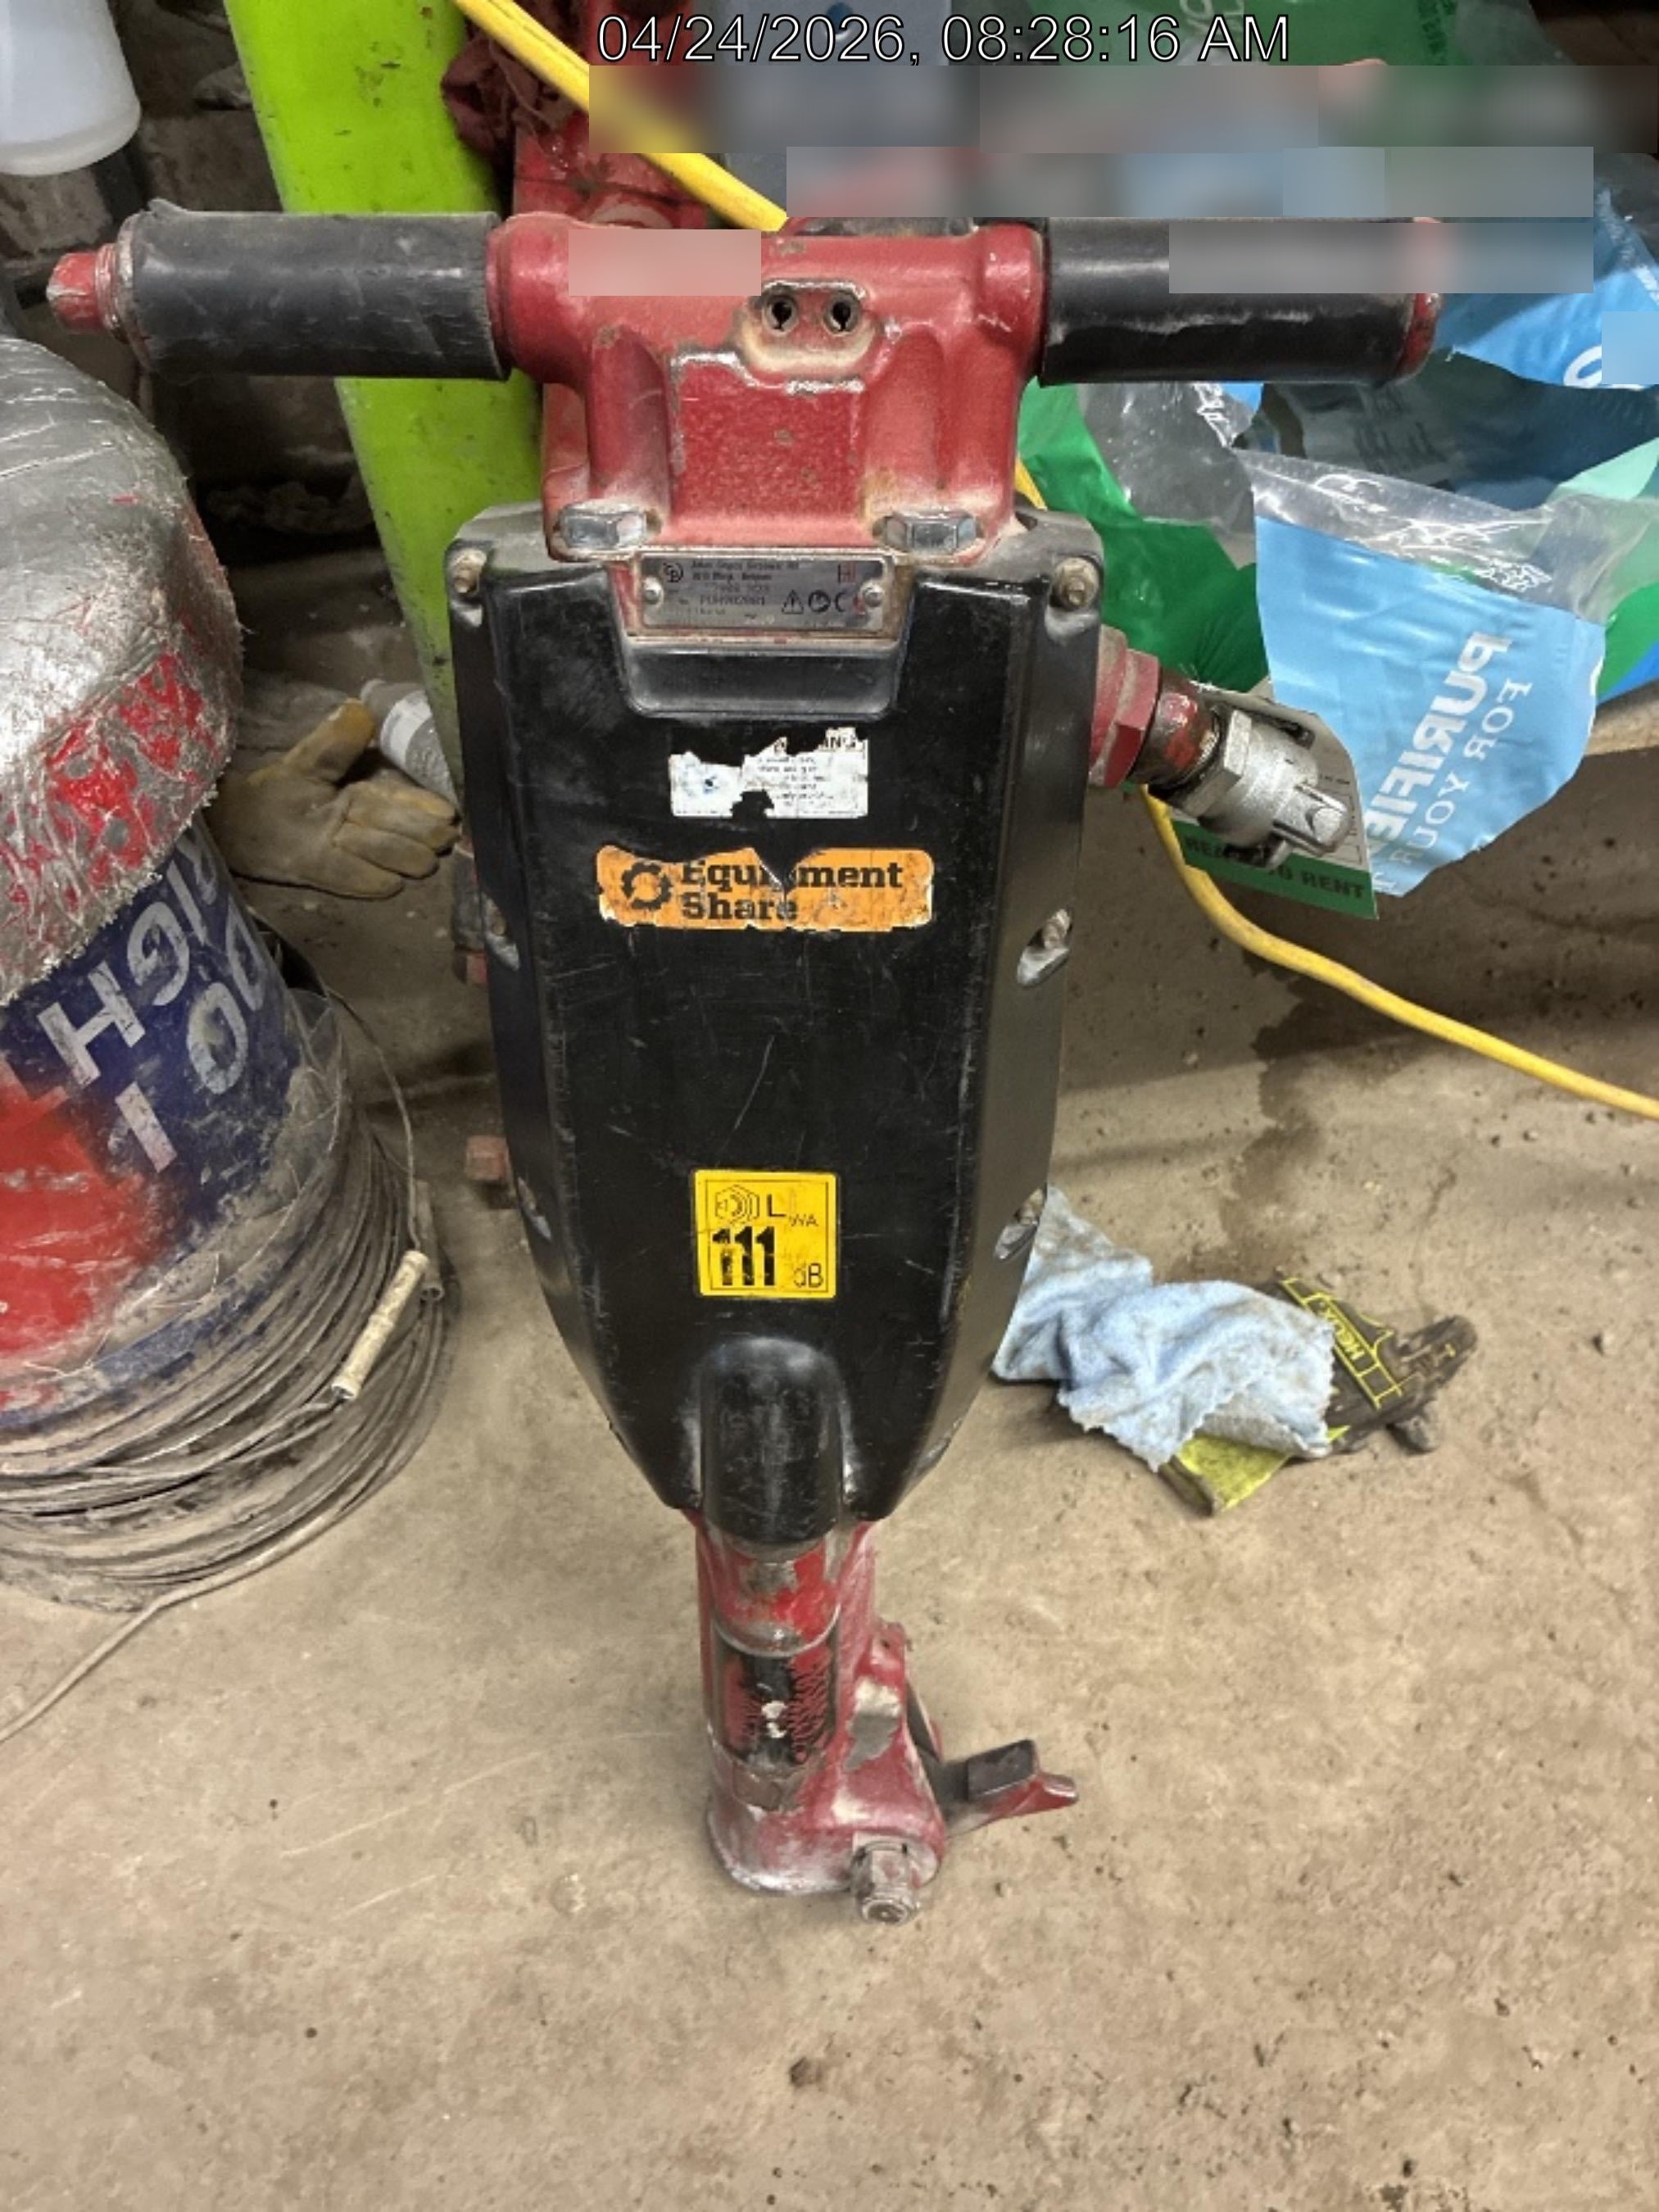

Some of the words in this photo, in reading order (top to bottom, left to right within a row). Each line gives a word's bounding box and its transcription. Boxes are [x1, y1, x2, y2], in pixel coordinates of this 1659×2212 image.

[682, 860, 903, 892] Equiment
[1301, 870, 1365, 899] RENT
[682, 891, 798, 920] Share
[712, 1226, 775, 1286] 111
